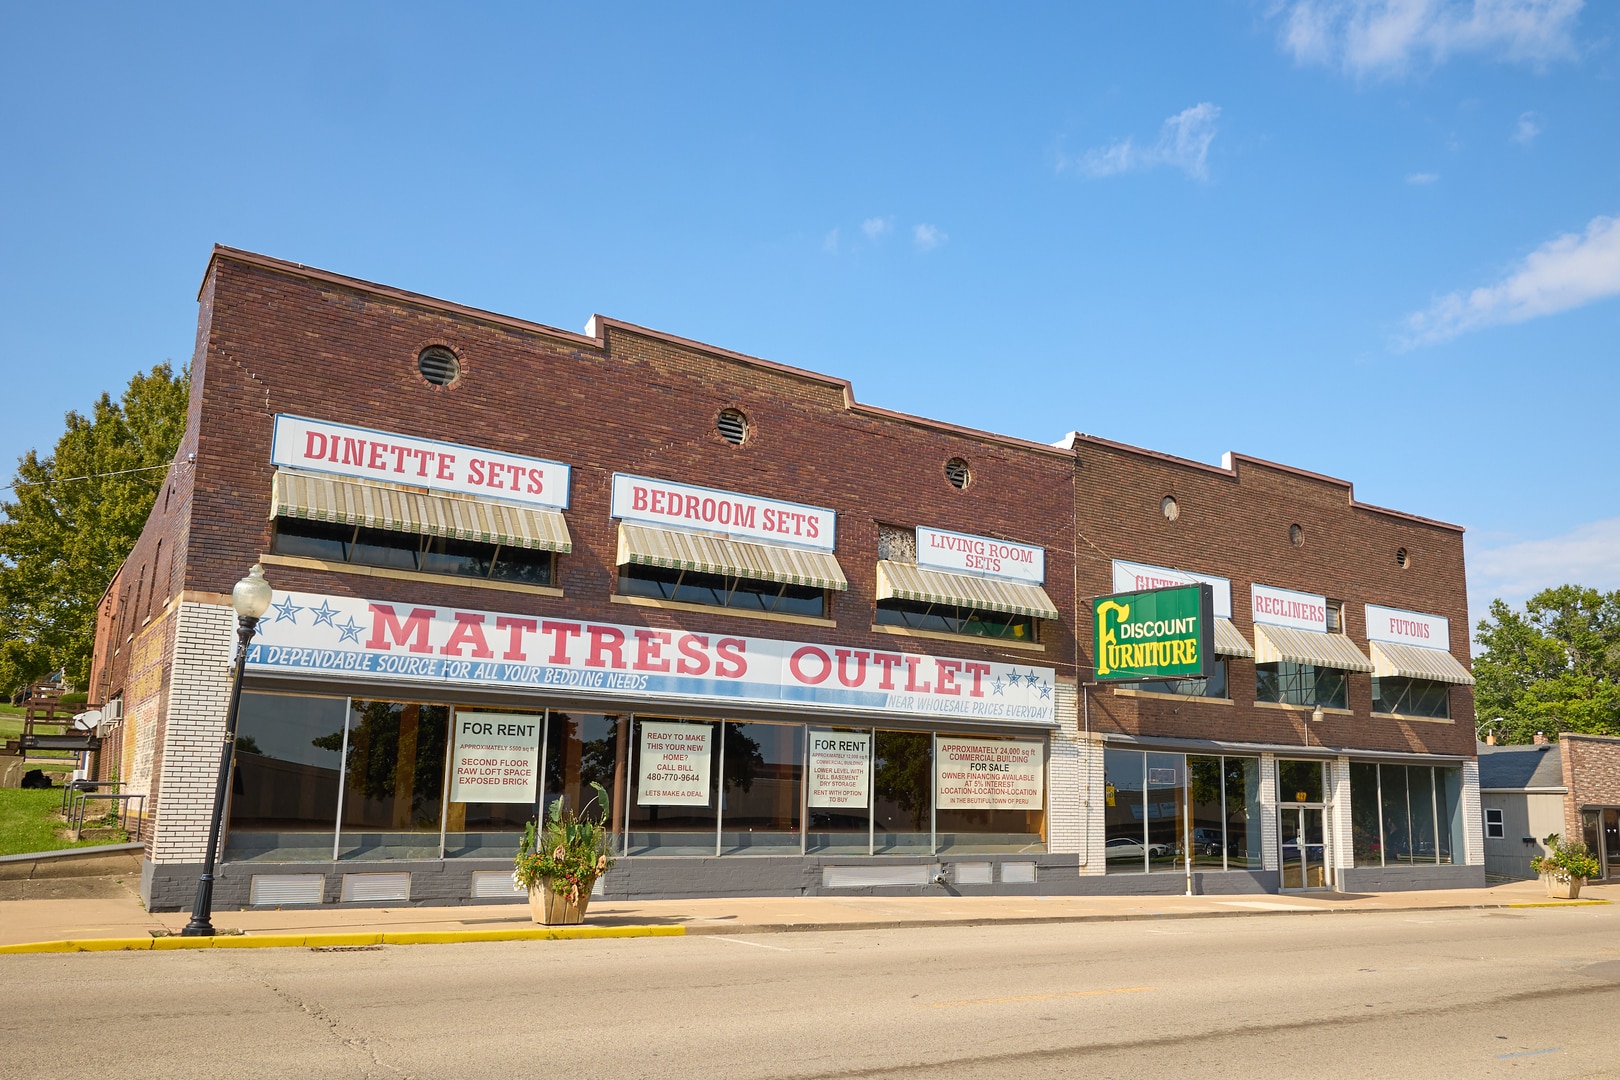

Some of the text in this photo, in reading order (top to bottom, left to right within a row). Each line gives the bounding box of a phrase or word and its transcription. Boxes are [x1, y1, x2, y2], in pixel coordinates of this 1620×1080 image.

[304, 431, 544, 495] DINETTE SETS
[632, 486, 819, 538] BEDROOM SETS
[930, 534, 1033, 563] LIVING ROOM
[965, 554, 1000, 572] SETS
[1256, 593, 1325, 622] RECLINERS
[1121, 617, 1196, 639] DISCOUNT
[1389, 618, 1430, 639] FUTONS
[1097, 601, 1197, 675] FURNITURE
[366, 603, 990, 697] MATTRESS OUTLET
[248, 645, 649, 690] A DEPENDABLE SOURCE FOR ALL YOUR BEDDING NEEDS
[887, 695, 914, 710] NEAR
[917, 698, 970, 713] WHOLESALE
[972, 702, 1004, 716] PRICES
[462, 722, 535, 736] FOR RENT
[647, 732, 672, 740] READY
[815, 740, 866, 752] FOR RENT
[942, 744, 998, 754] APPROXIMATELY
[1000, 747, 1020, 755] 24,000
[461, 758, 529, 767] SECOND FLOOR
[949, 753, 1028, 763] COMMERCIAL BUILDING
[457, 767, 478, 775] RAW
[970, 763, 1009, 772] FOR SALE
[646, 773, 700, 781] 480-770-9644
[966, 772, 1000, 780] FINANCING
[1002, 773, 1034, 781] AVAILABLE
[941, 787, 1037, 795] LOCATION-LOCATION-LOCATION
[985, 780, 1014, 788] INTEREST
